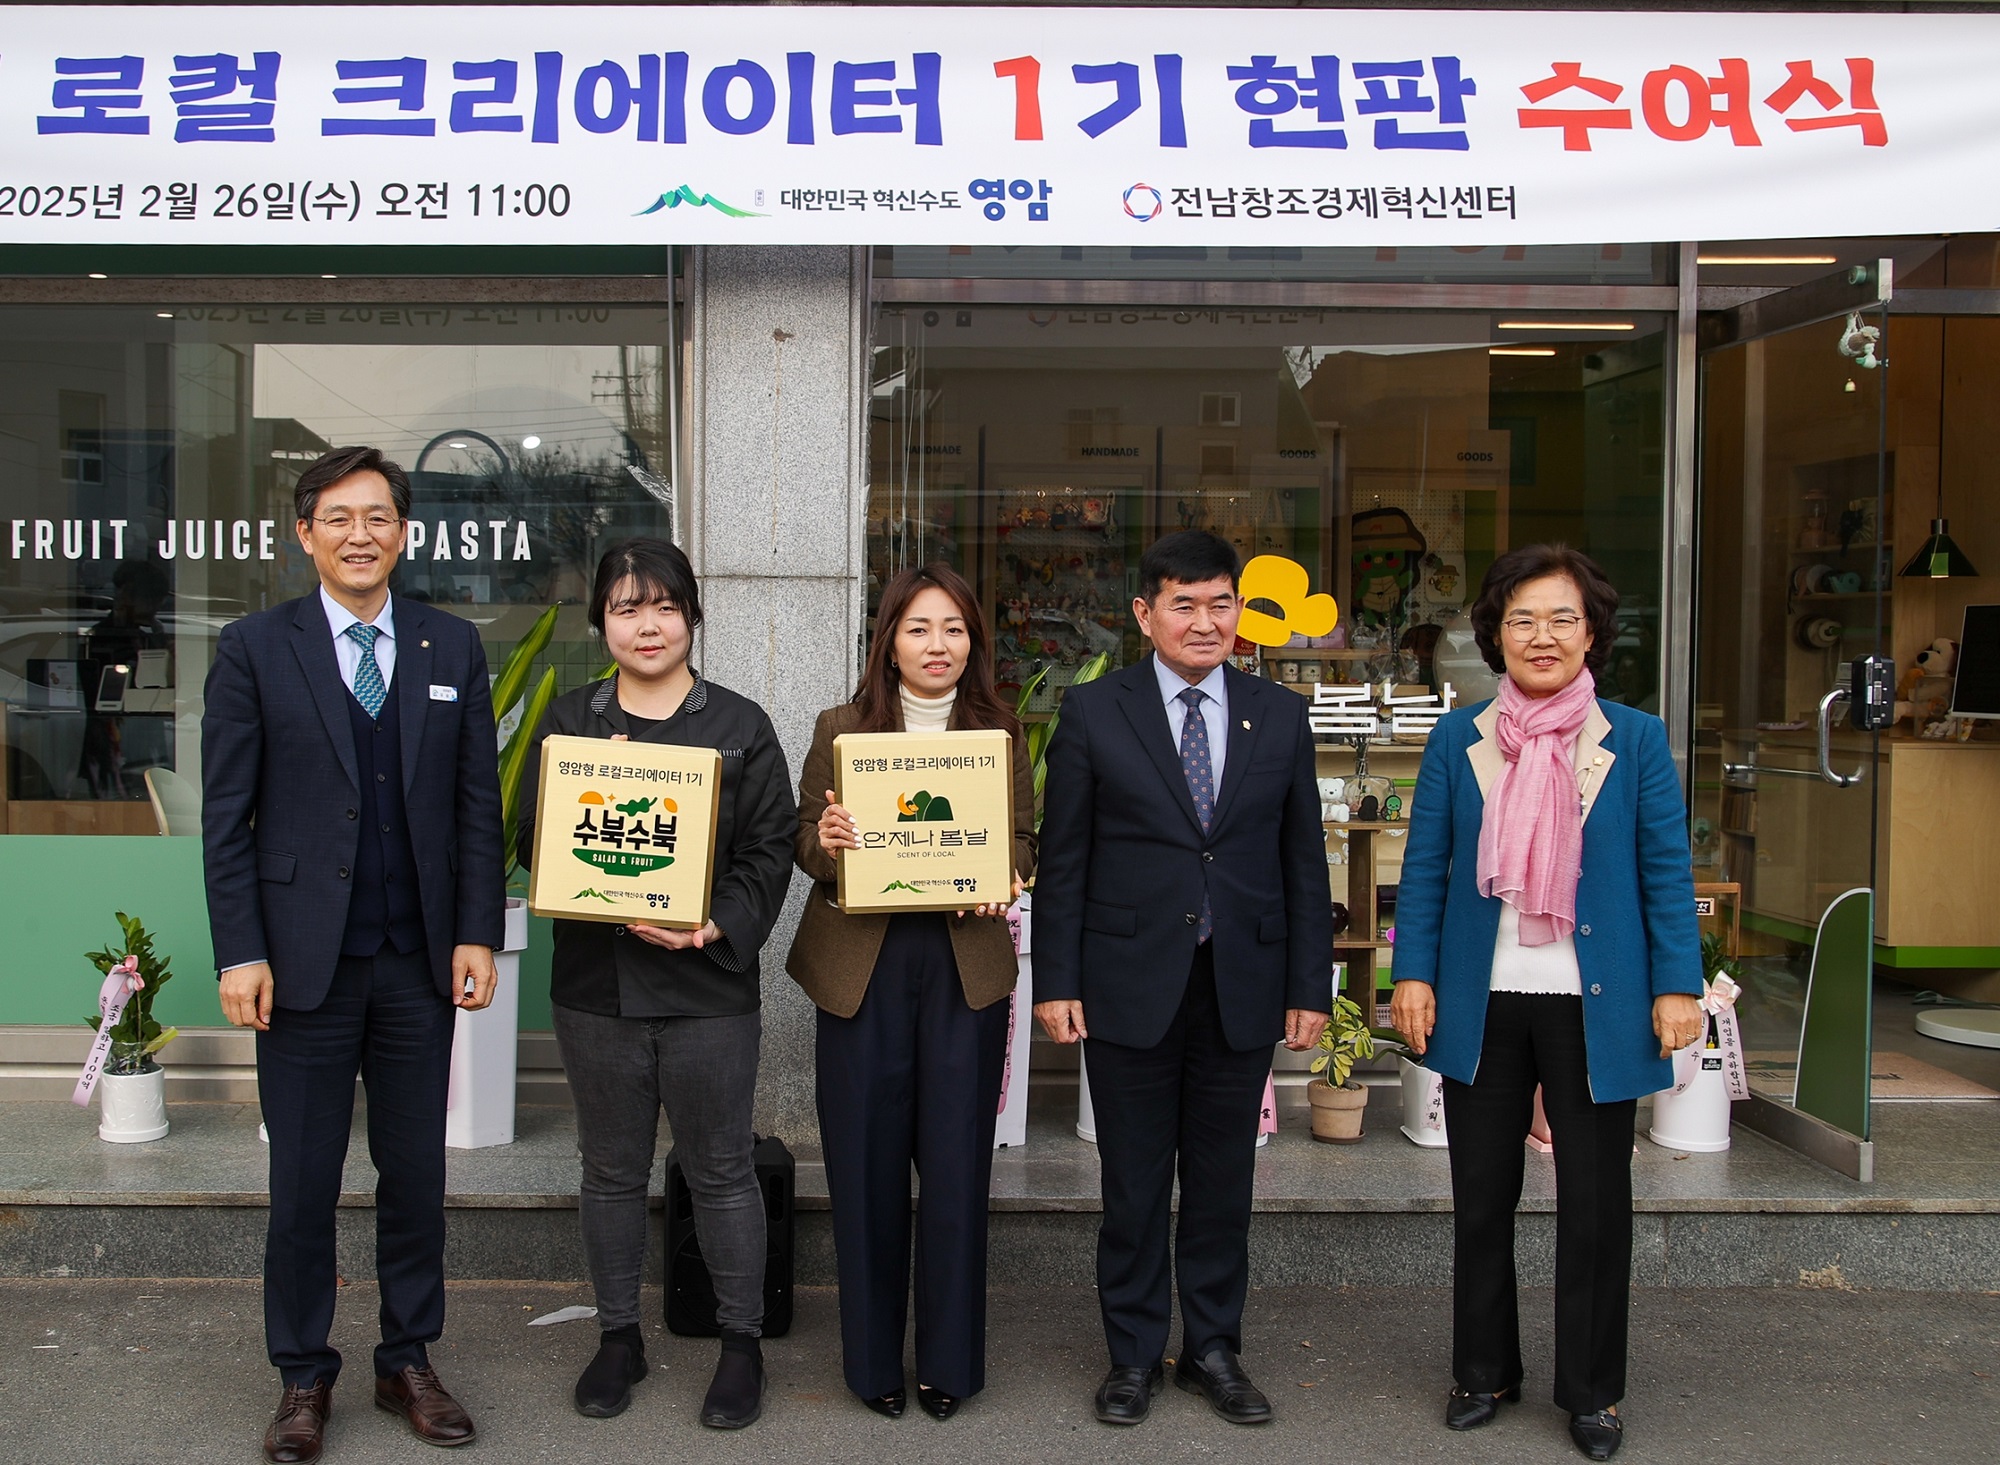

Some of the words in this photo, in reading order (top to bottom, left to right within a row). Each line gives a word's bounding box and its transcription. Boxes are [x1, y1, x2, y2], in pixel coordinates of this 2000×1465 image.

[36, 51, 281, 143] 로컬
[321, 51, 943, 146] 크리에이터
[993, 53, 1187, 148] 1기
[1226, 54, 1476, 152] 현판
[1517, 57, 1889, 151] 수여식
[0, 183, 124, 220] 2025년
[139, 182, 198, 220] 2월
[213, 181, 360, 221] 26일(수)
[375, 182, 450, 219] 오전
[471, 183, 570, 217] 11:00
[780, 188, 868, 211] 대한민국
[872, 189, 962, 212] 혁신수도
[968, 178, 1053, 221] 영암
[1170, 186, 1517, 220] 전남창조경제혁신센터
[1081, 446, 1140, 457] HANDMADE
[1279, 449, 1317, 459] GOODS
[1456, 451, 1494, 462] GOODS
[11, 519, 128, 560] FRUIT
[158, 519, 276, 560] JUICE
[407, 520, 532, 561] PASTA
[1309, 682, 1457, 734] 봄날
[558, 760, 595, 777] 영암형
[597, 764, 682, 784] 로컬크리에이터
[685, 772, 703, 786] 1기
[852, 758, 888, 773] 영암형
[891, 755, 975, 771] 로컬크리에이터
[978, 755, 996, 769] 1기
[572, 808, 678, 853] 수북수북
[863, 830, 934, 849] 언제나
[939, 828, 989, 848] 봄날
[592, 853, 617, 864] SALAD
[620, 855, 627, 864] &
[630, 857, 654, 867] FRUIT
[953, 878, 978, 893] 영암
[646, 893, 671, 909] 영암
[1722, 1017, 1735, 1047] 개업을
